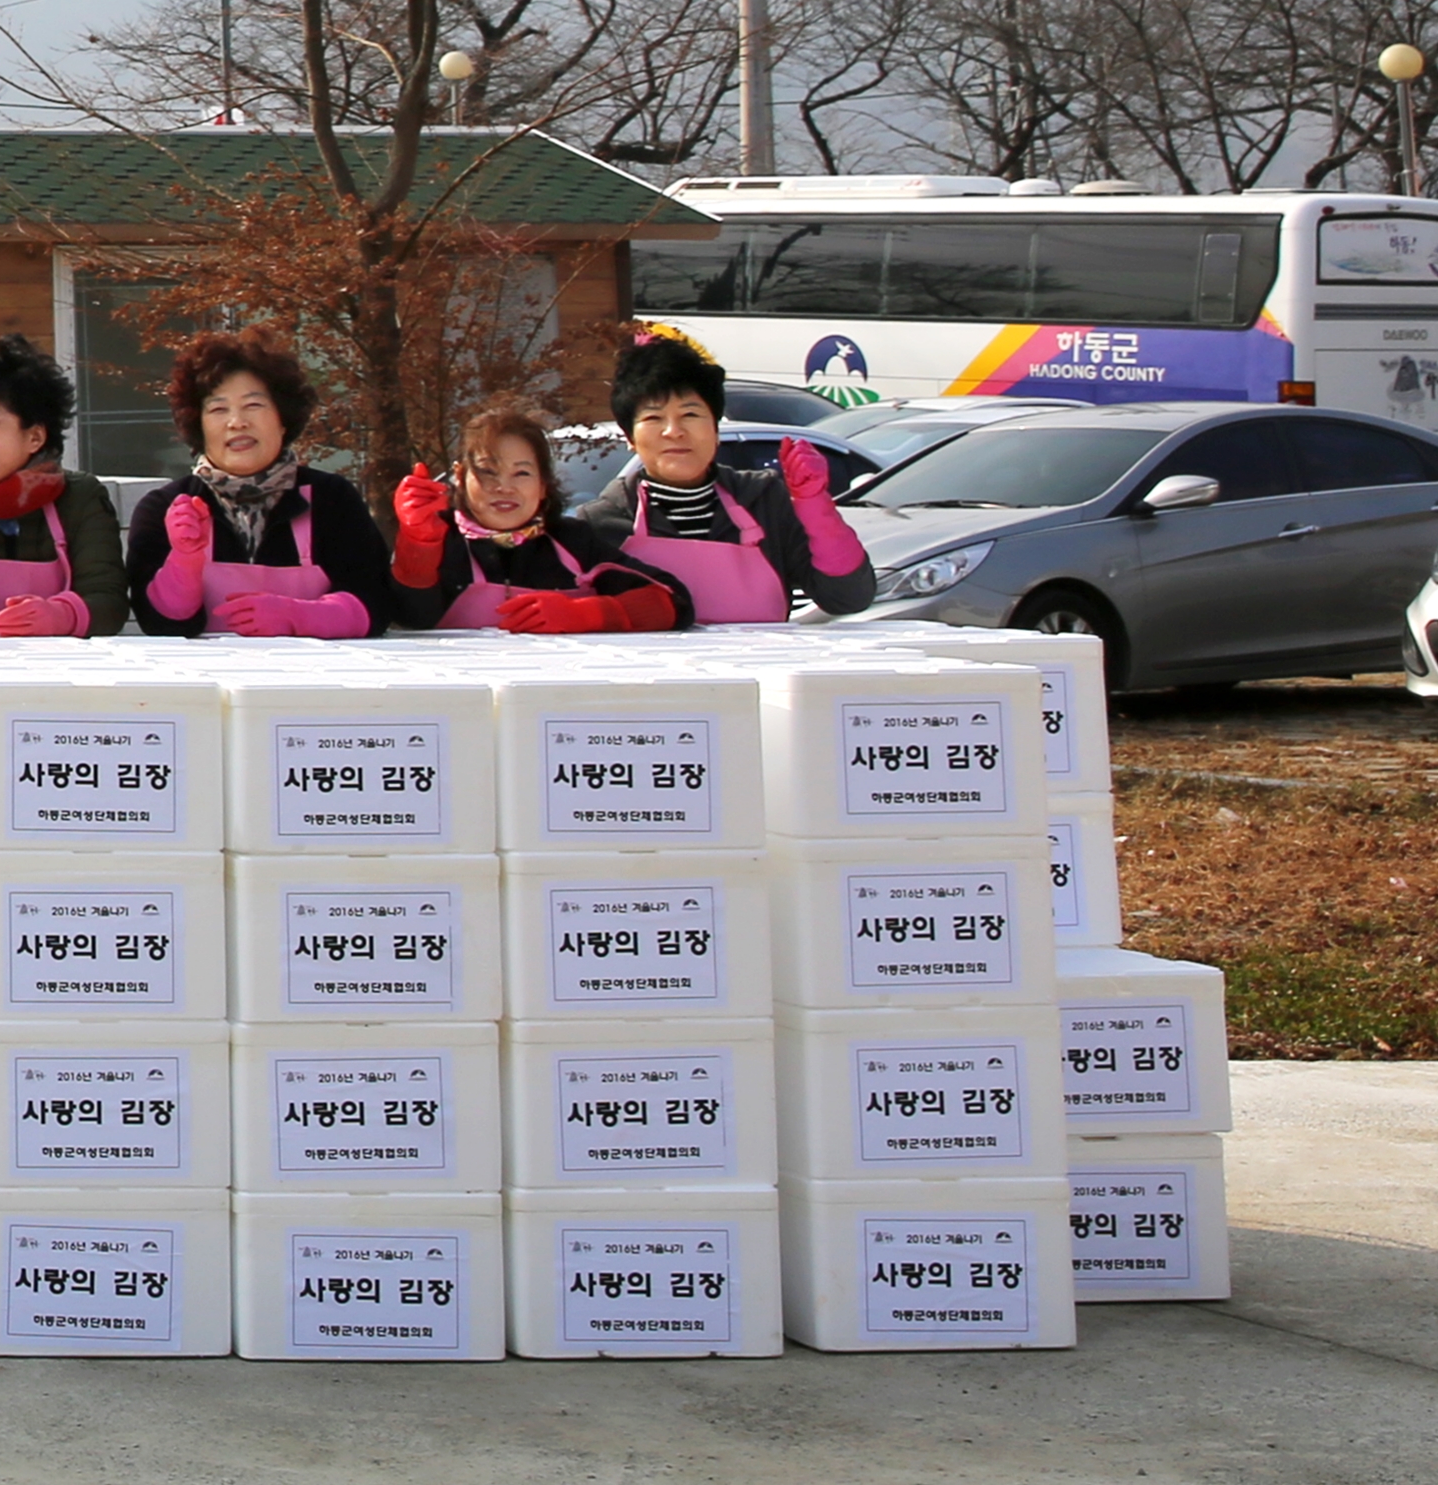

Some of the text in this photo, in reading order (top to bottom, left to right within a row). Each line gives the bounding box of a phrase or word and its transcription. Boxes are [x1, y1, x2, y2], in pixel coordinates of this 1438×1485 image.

[1382, 329, 1429, 341] DAEWOO
[1056, 331, 1139, 364] 하동군
[1029, 364, 1166, 382] HADONG COUNTY
[921, 716, 959, 728] 겨울나기
[93, 734, 132, 746] 겨울나기
[851, 744, 1000, 772] 사랑의 김장
[18, 762, 172, 791] 사랑의 김장
[870, 790, 982, 805] 하동군여성단체협의회
[37, 809, 151, 823] 하동군여성단체협의회
[368, 906, 407, 917] 겨울나기
[632, 901, 670, 913] 겨울나기
[294, 934, 448, 962] 사랑의 김장
[559, 929, 711, 958] 사랑의 김장
[313, 981, 427, 995] 하동군여성단체협의회
[579, 977, 692, 991] 하동군여성단체협의회
[937, 1060, 975, 1072] 겨울나기
[1061, 1046, 1183, 1074] 랑의 김장
[96, 1071, 135, 1082] 겨울나기
[866, 1088, 1015, 1117] 사랑의 김장
[22, 1099, 176, 1126] 사랑의 김장
[886, 1135, 997, 1151] 하동군여성단체협의회
[41, 1146, 155, 1159] 하동군여성단체협의회
[374, 1249, 414, 1261] 겨울나기
[645, 1243, 684, 1255] 겨울나기
[299, 1277, 454, 1306] 사랑의 김장
[570, 1272, 726, 1299] 사랑의 김장
[318, 1324, 433, 1339] 하동군여성단체협의회
[589, 1319, 705, 1332] 하동군여성단체협의회
